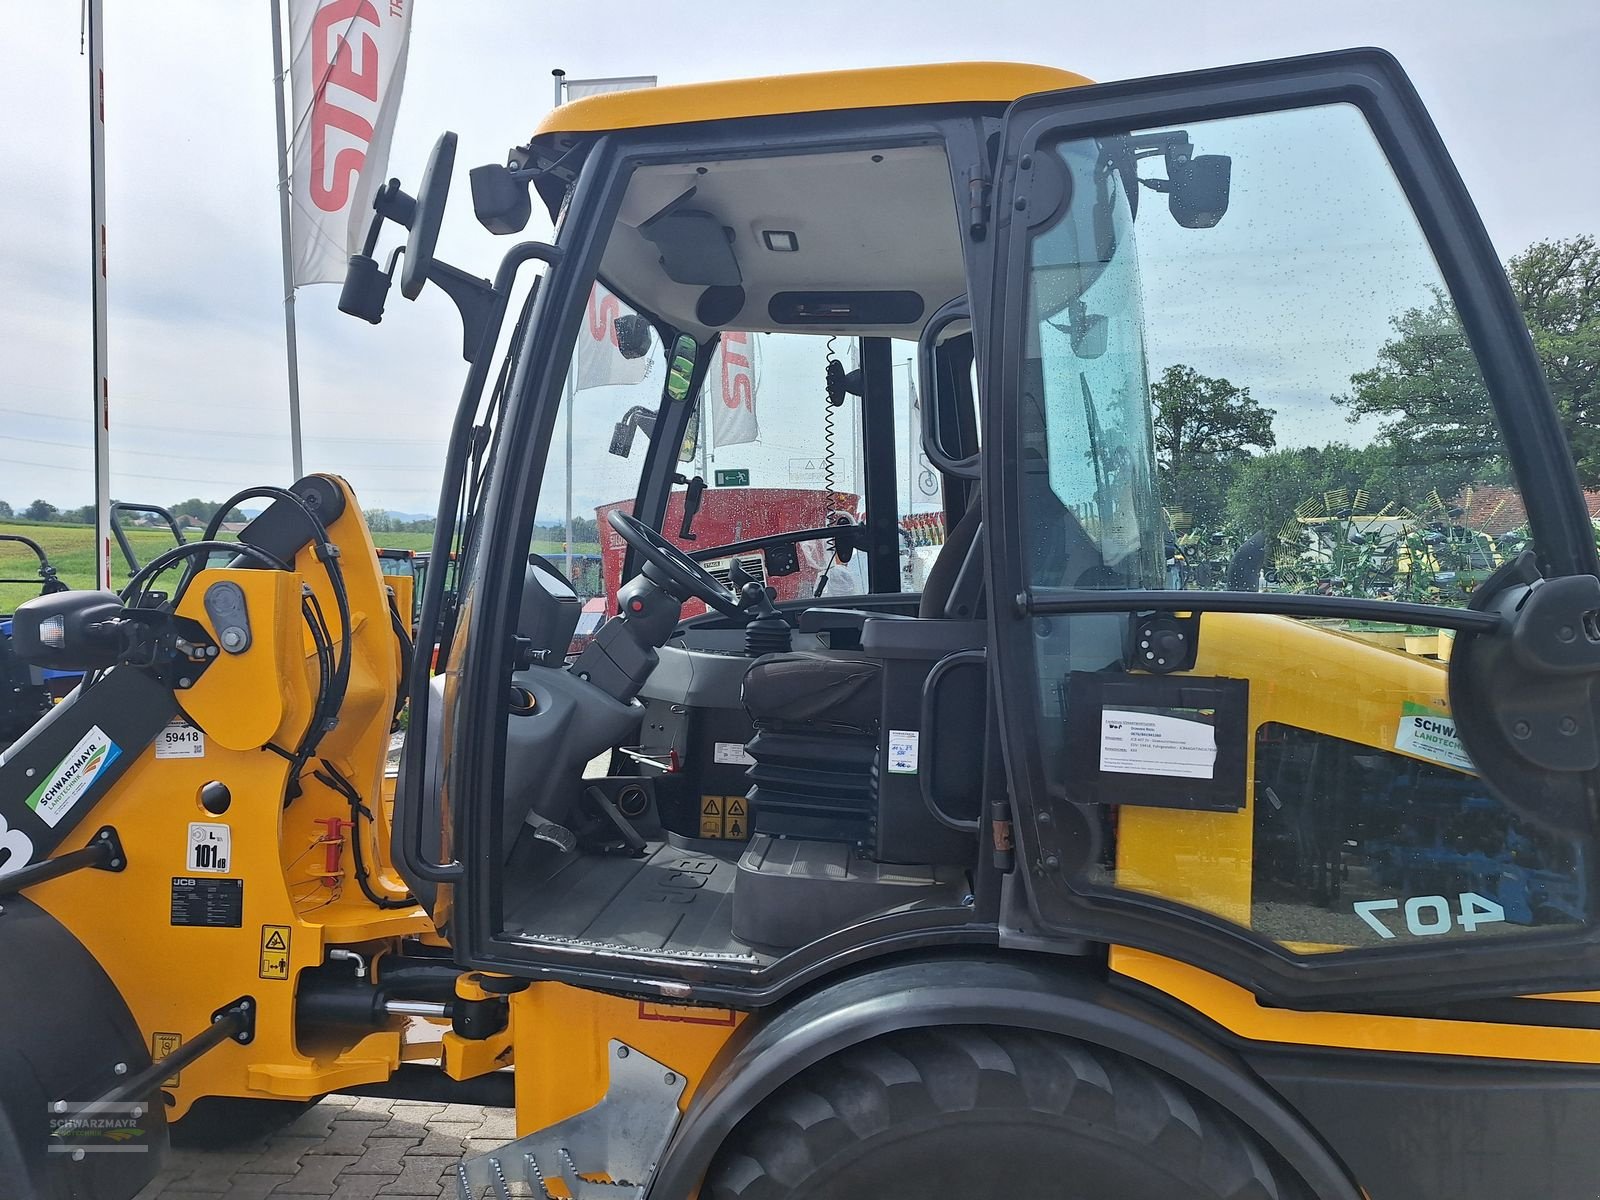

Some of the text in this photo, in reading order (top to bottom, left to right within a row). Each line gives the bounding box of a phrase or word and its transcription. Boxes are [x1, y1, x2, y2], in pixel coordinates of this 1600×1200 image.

[165, 732, 199, 742] 59418
[40, 744, 97, 807] SCHWARZMAYR
[48, 774, 82, 810] LANDTECHNIK
[195, 844, 218, 868] 101
[173, 878, 196, 886] JCB
